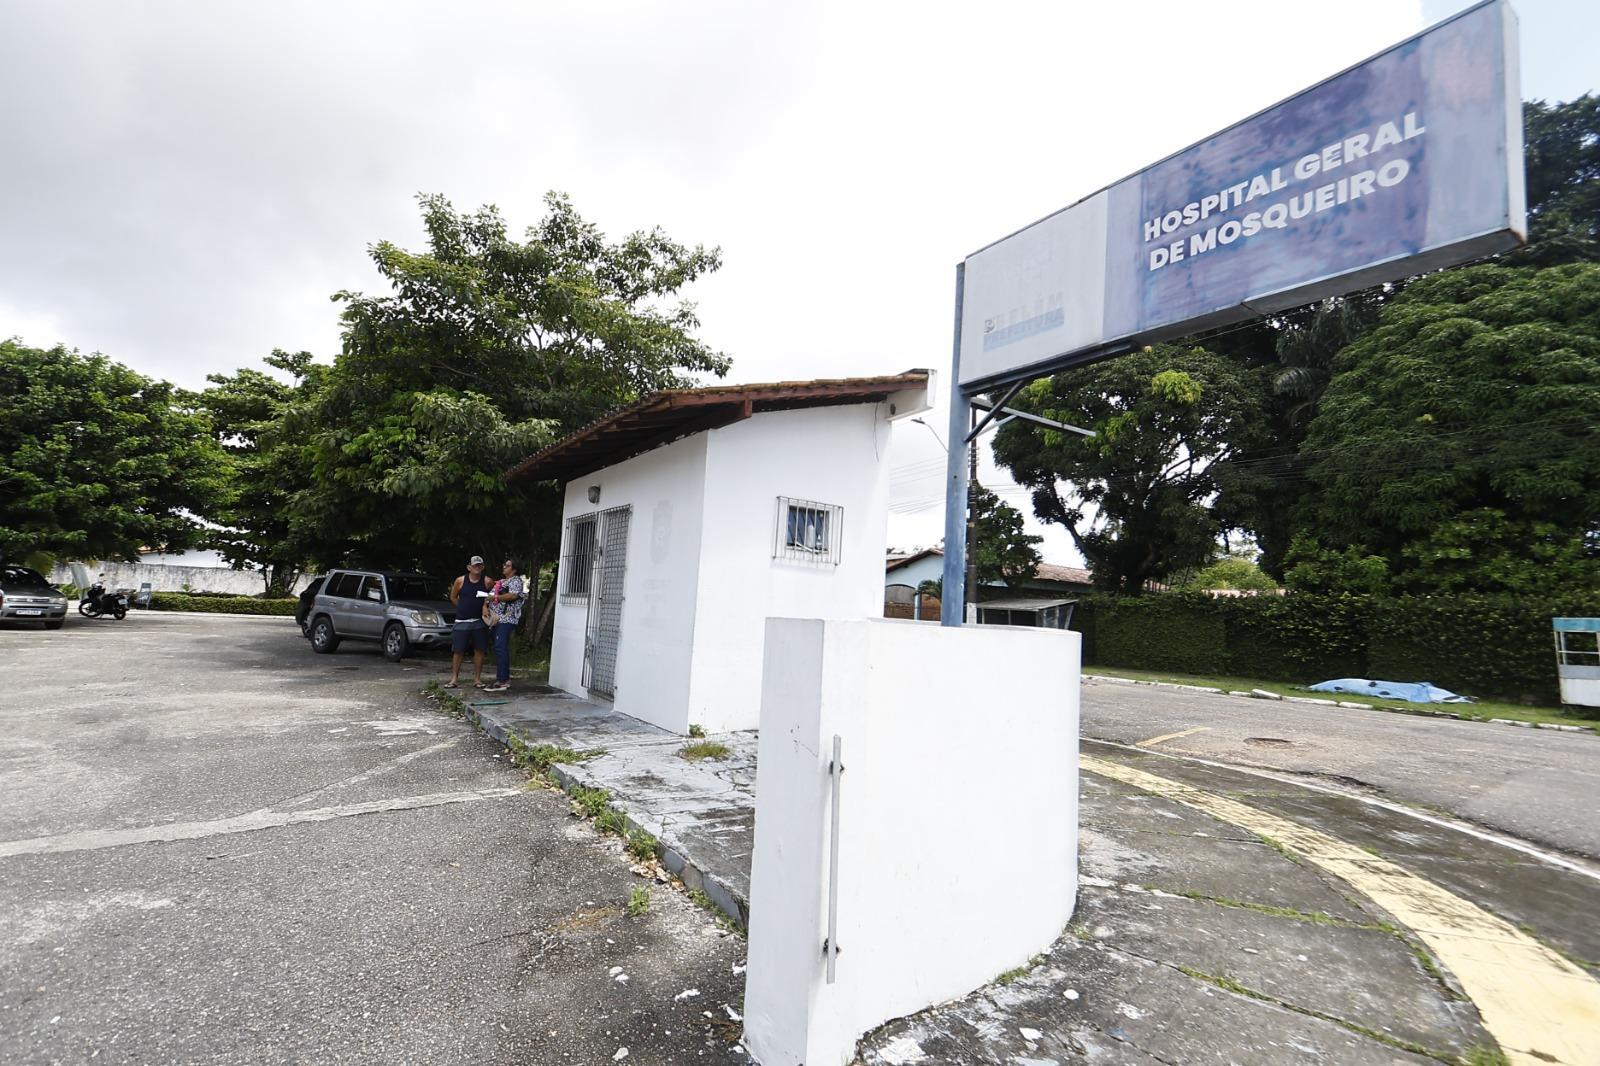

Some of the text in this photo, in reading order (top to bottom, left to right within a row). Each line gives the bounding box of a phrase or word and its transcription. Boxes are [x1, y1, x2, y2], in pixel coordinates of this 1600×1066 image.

[1143, 111, 1426, 242] HOSPITAL GERAL
[1149, 158, 1411, 272] DE MOSQUEIRO
